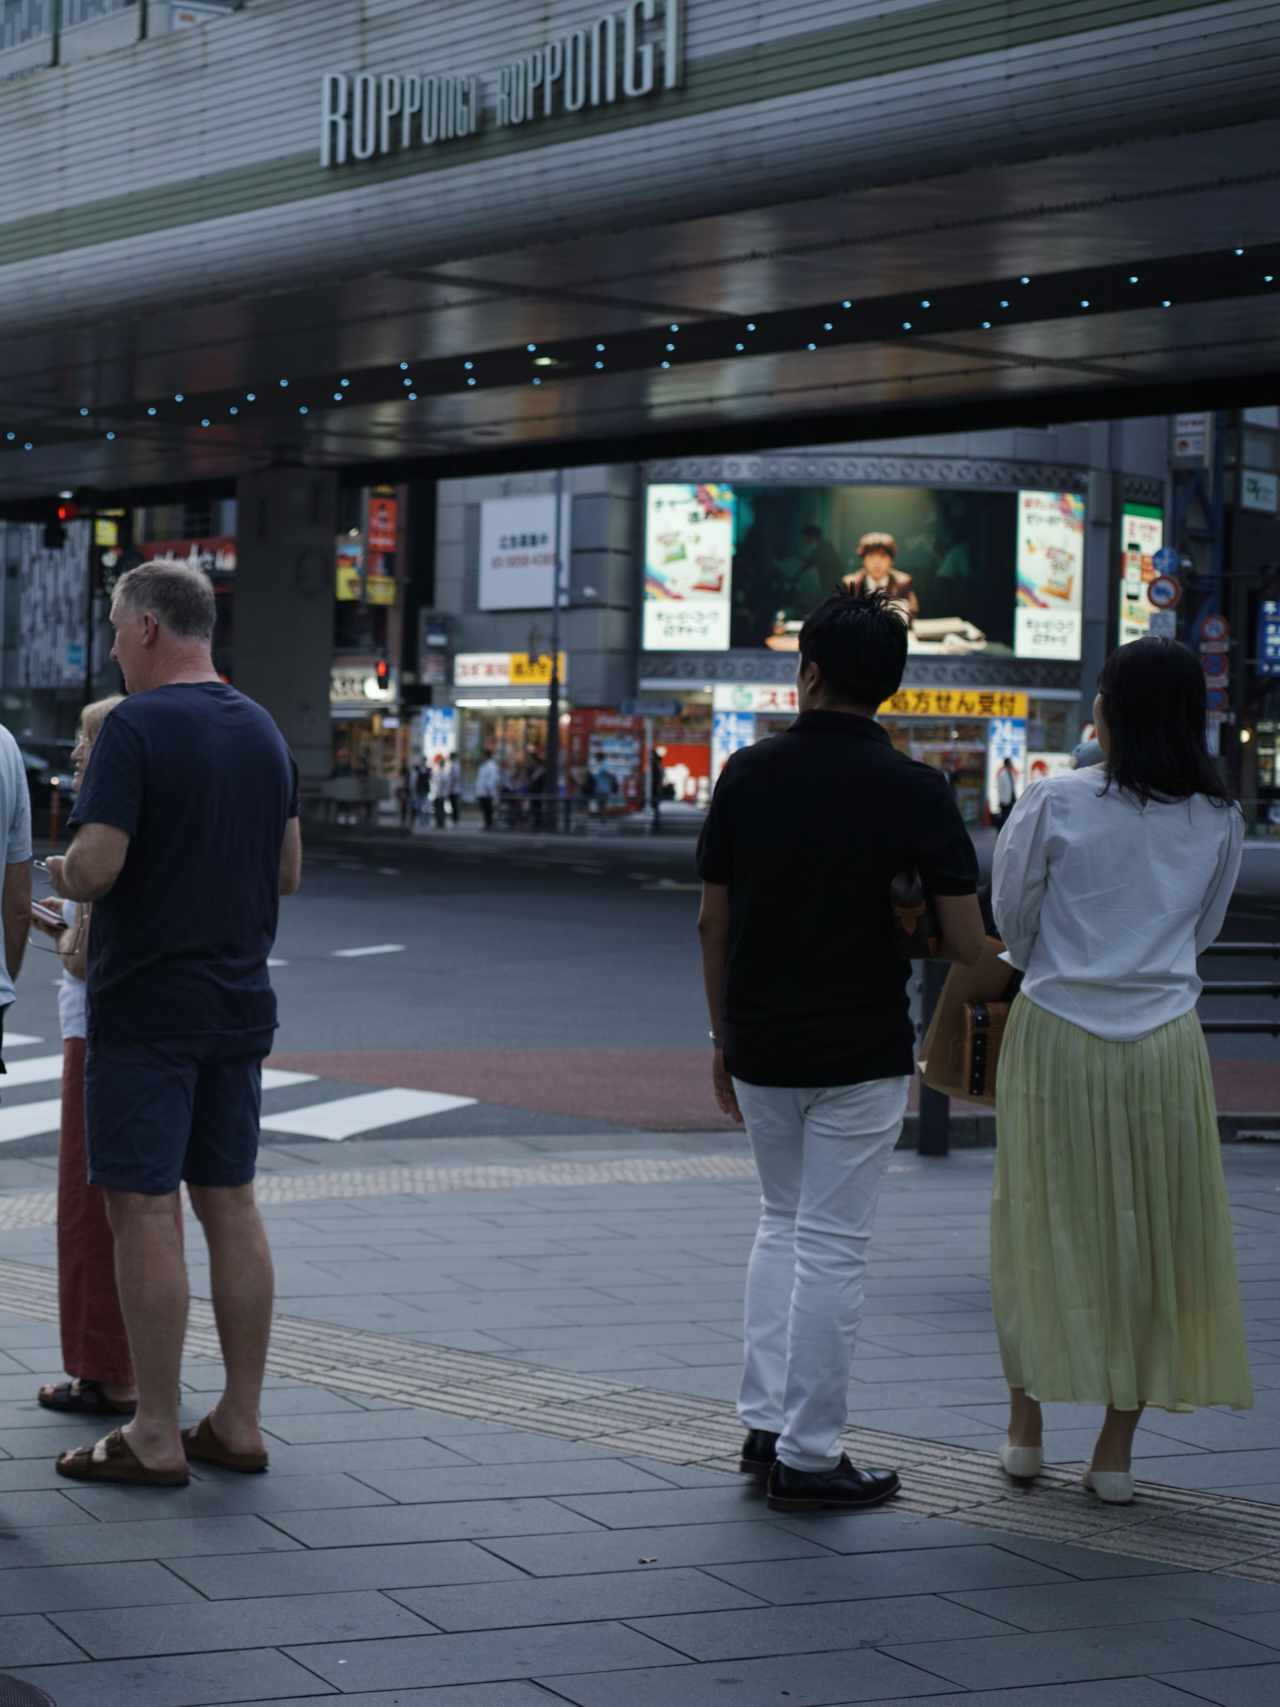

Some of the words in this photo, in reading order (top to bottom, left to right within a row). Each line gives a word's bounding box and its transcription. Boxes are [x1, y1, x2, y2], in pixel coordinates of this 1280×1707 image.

[320, 72, 477, 167] ROPPONGI
[496, 0, 676, 126] ROPPONGI
[889, 689, 1017, 716] 処方せん受付
